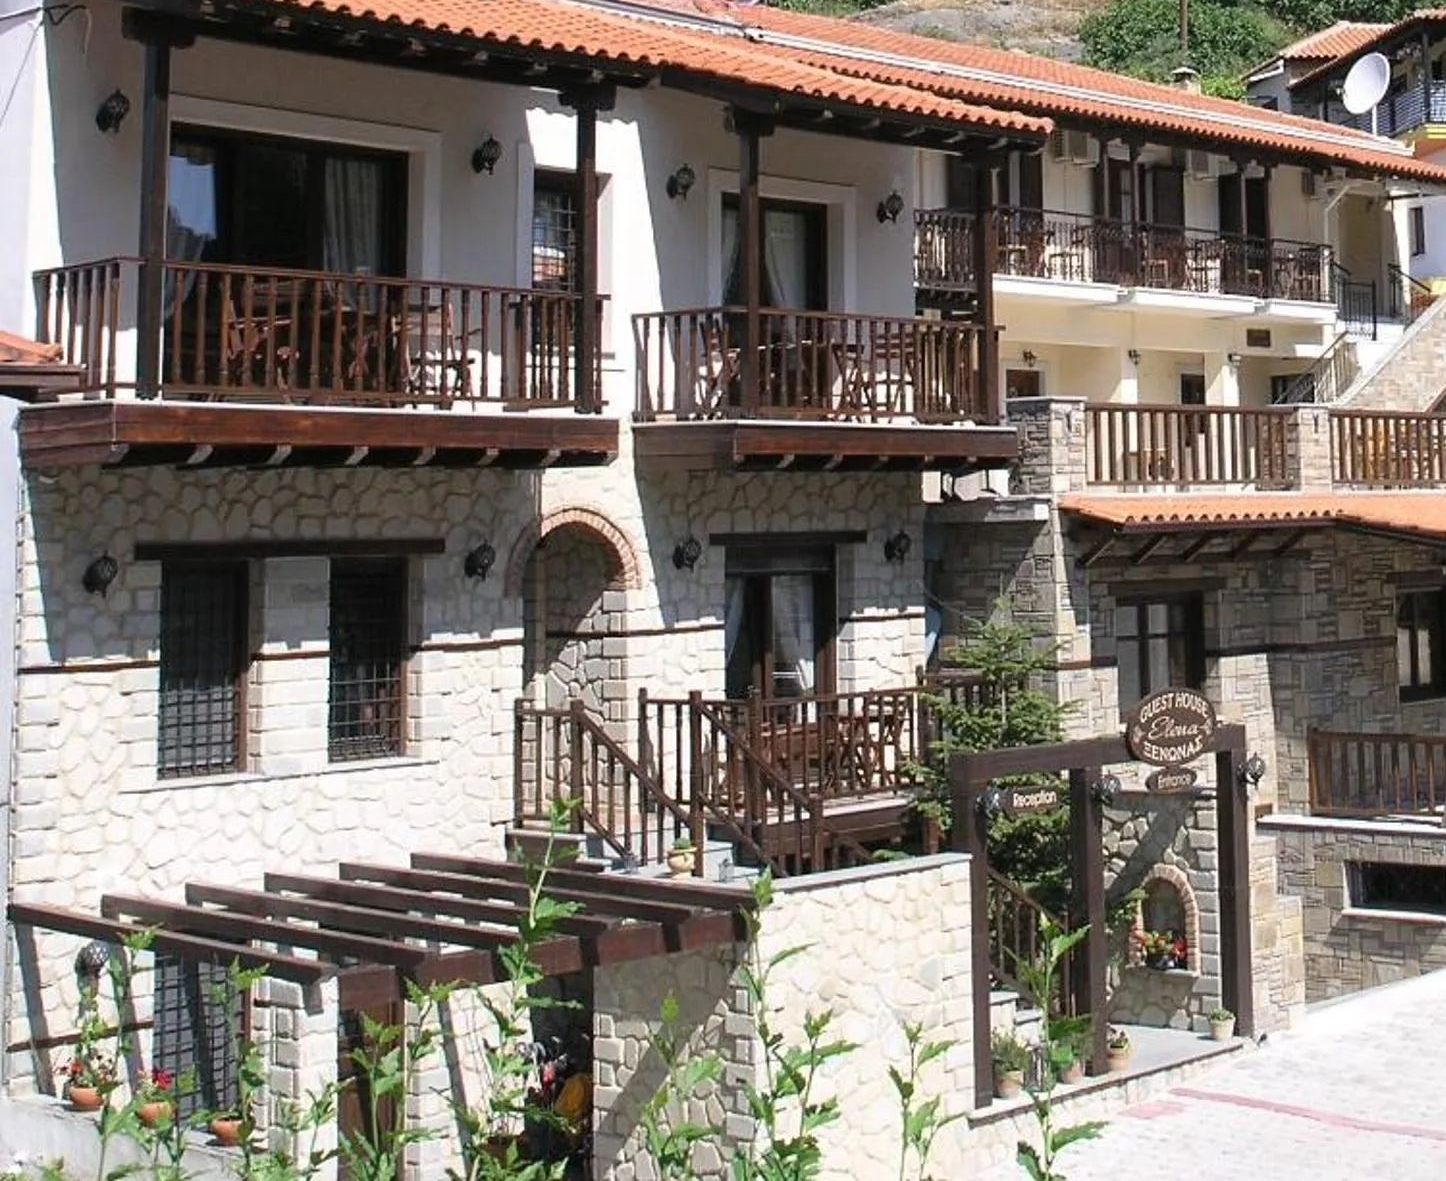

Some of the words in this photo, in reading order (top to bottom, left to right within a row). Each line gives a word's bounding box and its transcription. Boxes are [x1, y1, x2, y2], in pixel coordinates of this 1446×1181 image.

[1139, 692, 1175, 723] GUEST
[1175, 691, 1209, 718] HOUSE
[1147, 715, 1199, 740] Elena
[1013, 789, 1057, 808] Reception
